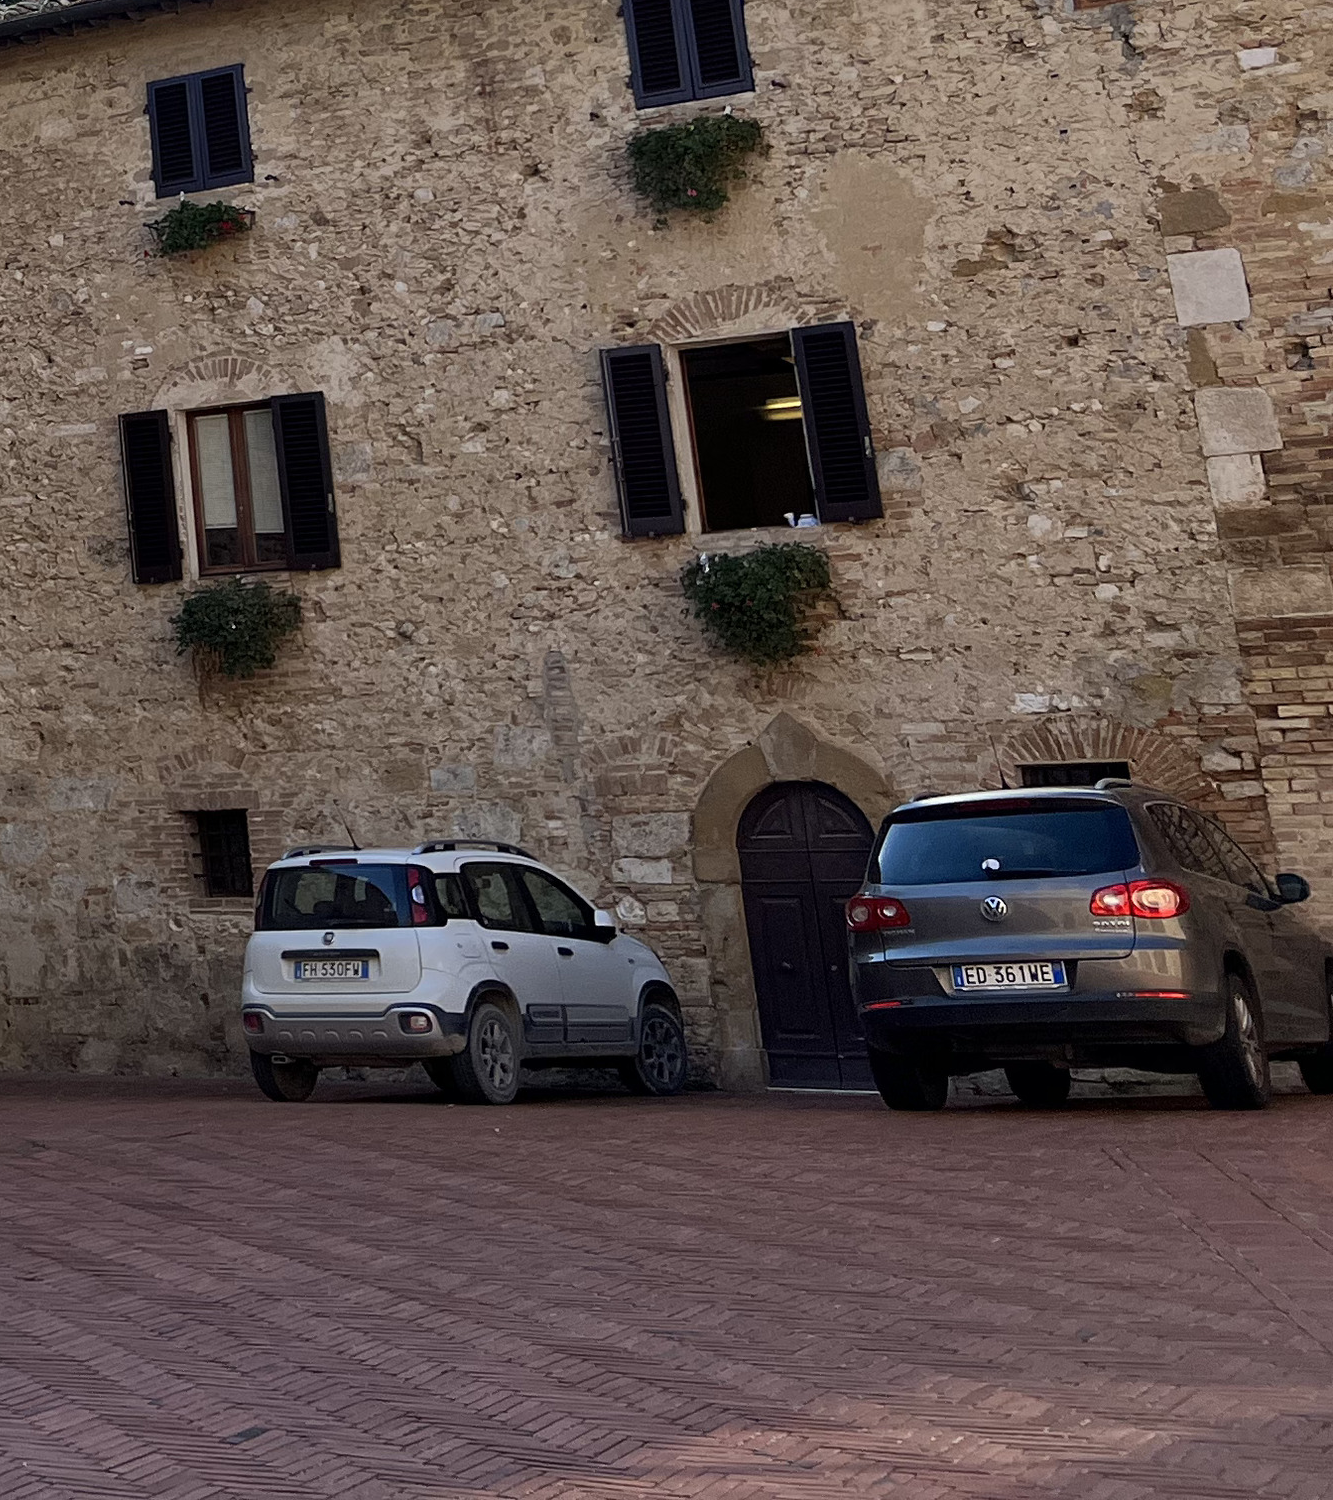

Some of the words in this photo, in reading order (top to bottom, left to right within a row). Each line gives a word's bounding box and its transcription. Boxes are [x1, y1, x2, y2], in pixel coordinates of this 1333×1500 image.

[303, 963, 317, 977] FH
[321, 962, 360, 977] 530FW
[965, 967, 987, 984] ED
[993, 964, 1052, 983] 361WE
